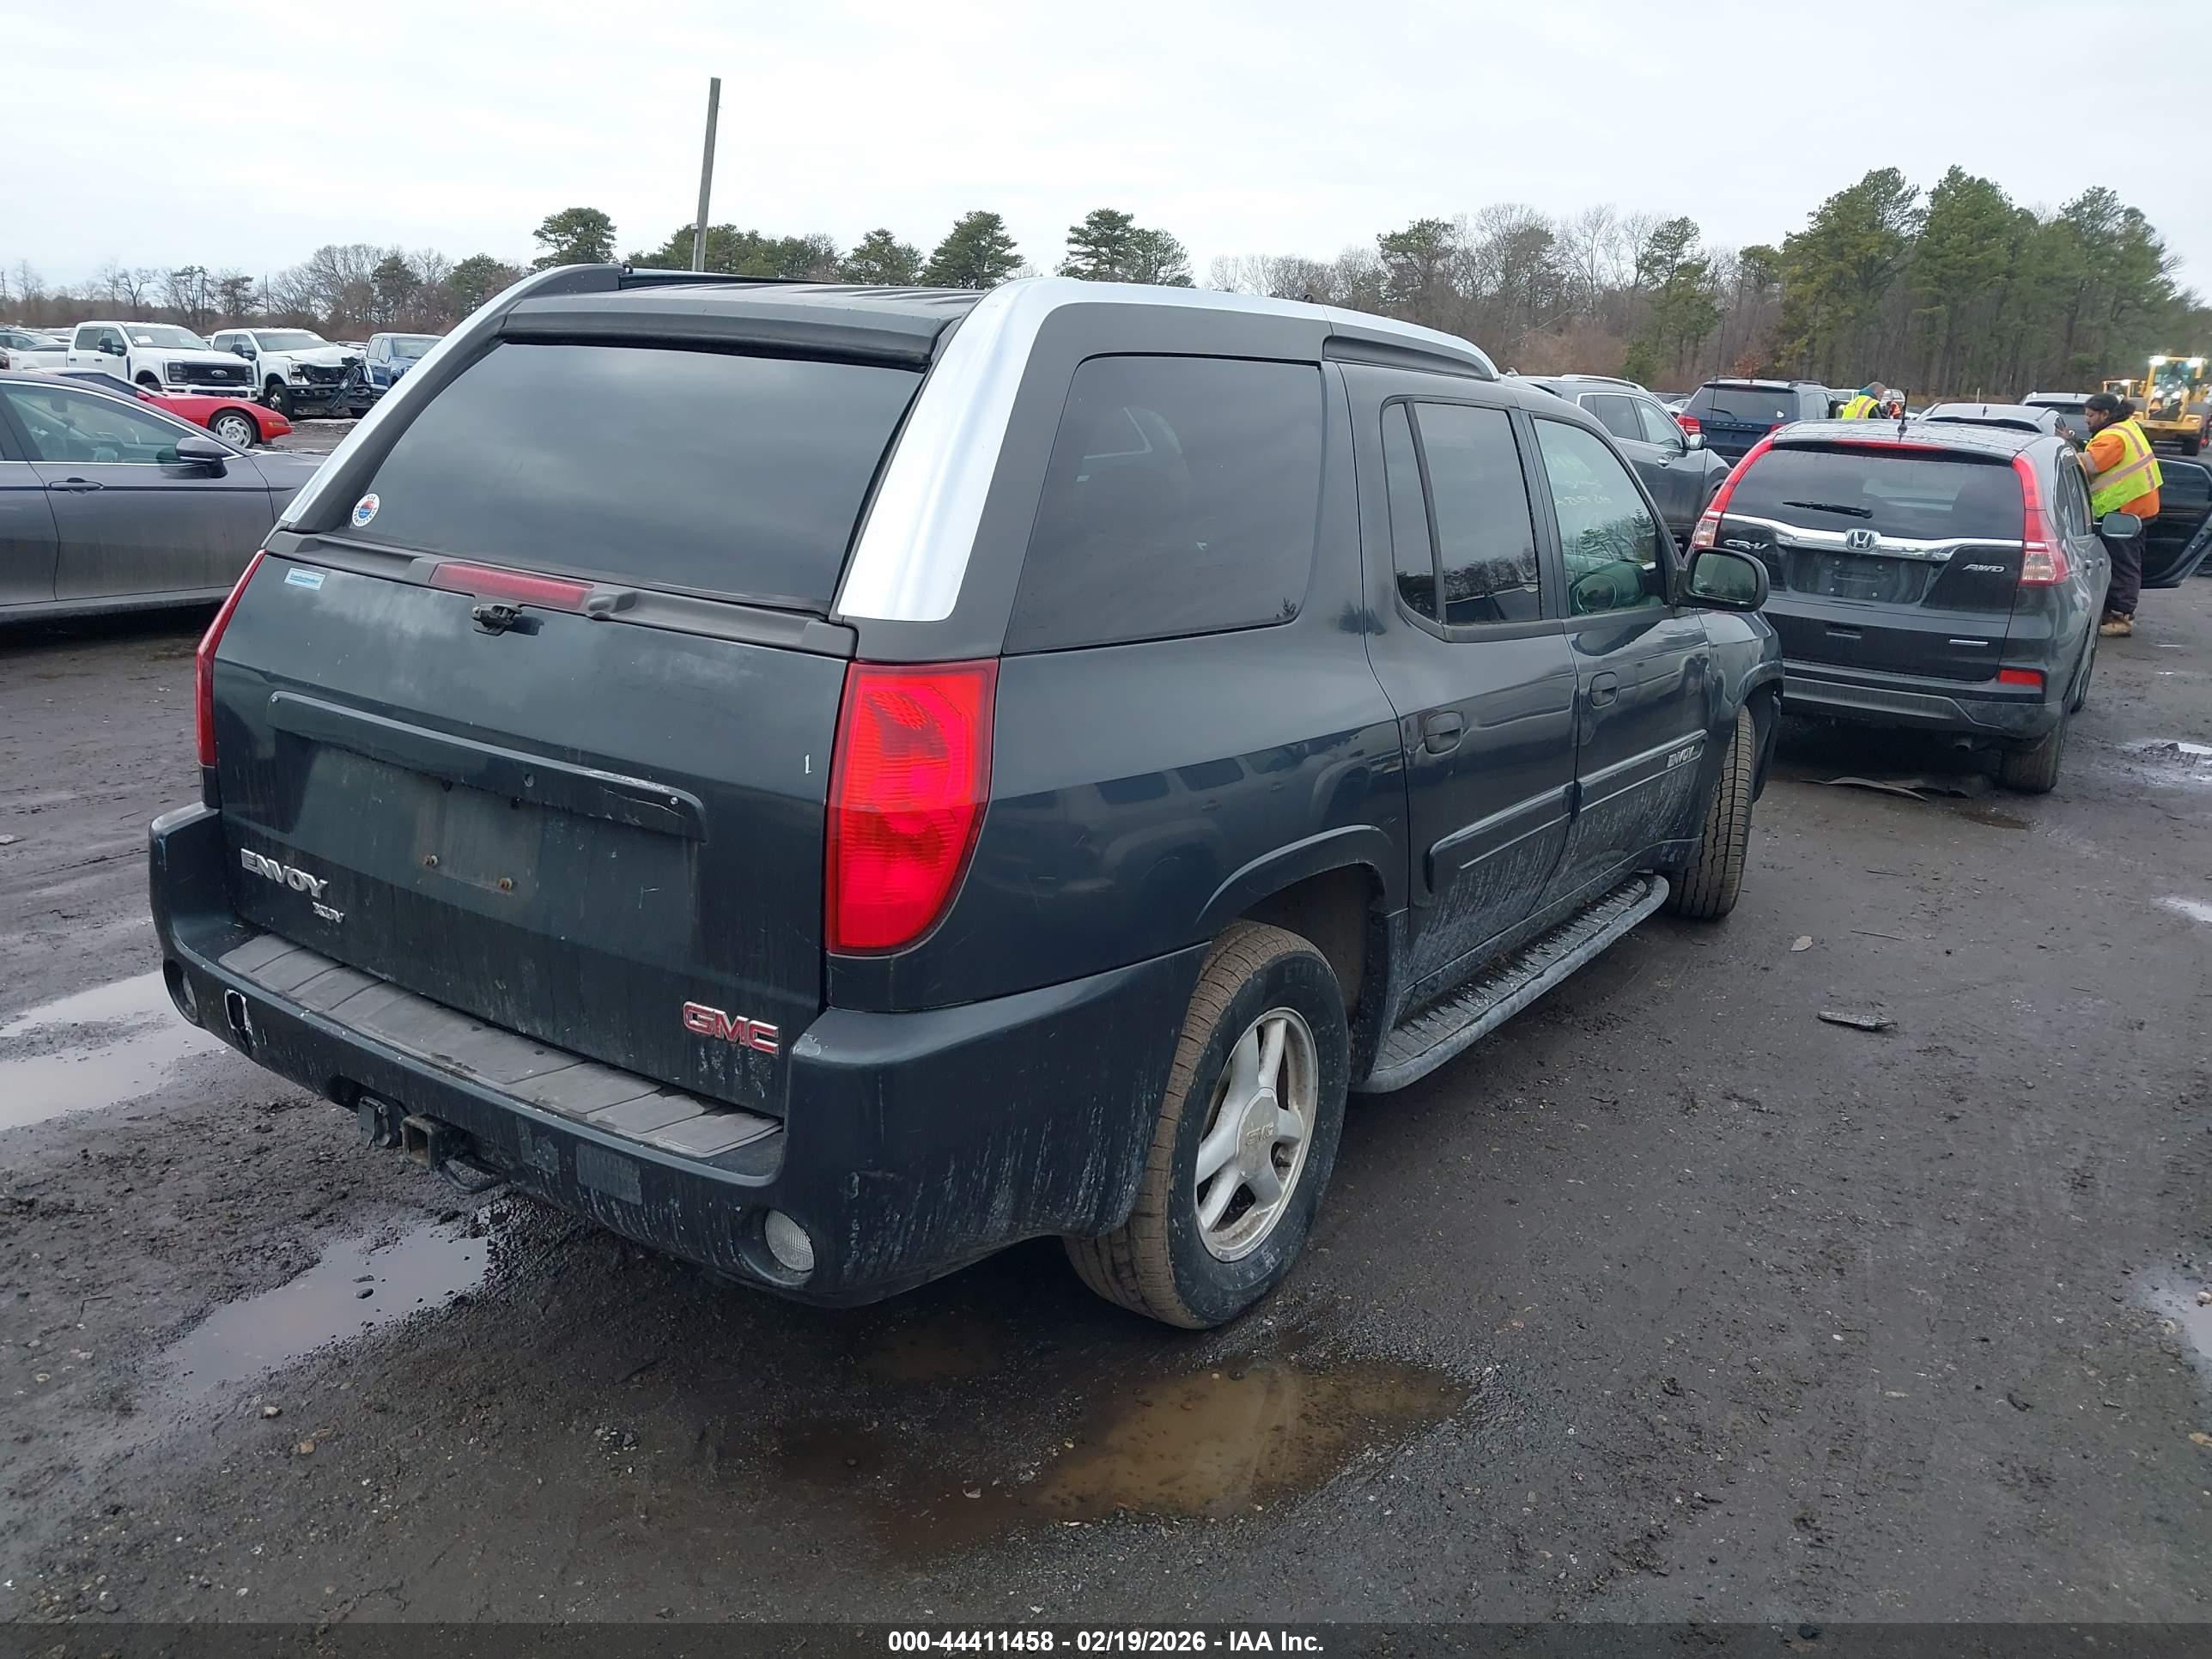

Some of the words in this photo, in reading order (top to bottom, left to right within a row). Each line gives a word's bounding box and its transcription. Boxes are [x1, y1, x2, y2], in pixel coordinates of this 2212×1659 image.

[1723, 539, 1769, 550] CR-V
[1962, 563, 2005, 573] AWD
[240, 848, 329, 899] ENVOY
[683, 1000, 780, 1056] GMC
[1246, 1121, 1274, 1145] GMC
